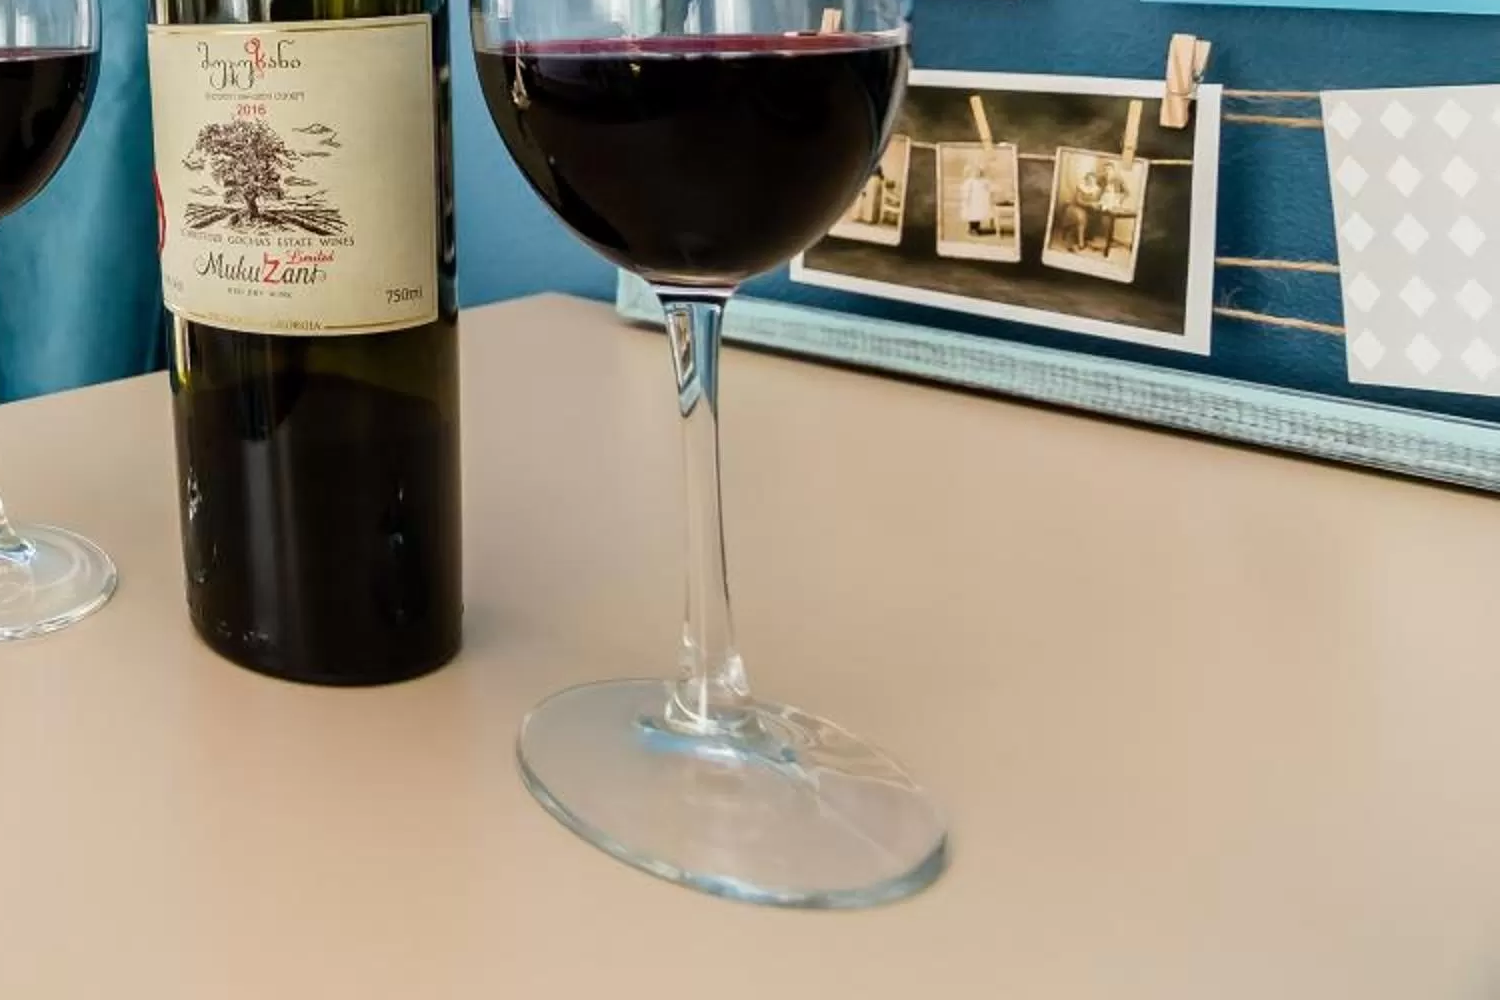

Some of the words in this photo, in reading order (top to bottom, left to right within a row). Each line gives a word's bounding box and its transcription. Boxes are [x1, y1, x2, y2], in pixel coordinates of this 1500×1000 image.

[236, 103, 267, 116] 2016
[277, 237, 313, 247] ESTATE
[319, 236, 355, 247] WINES
[385, 284, 423, 304] 750ml
